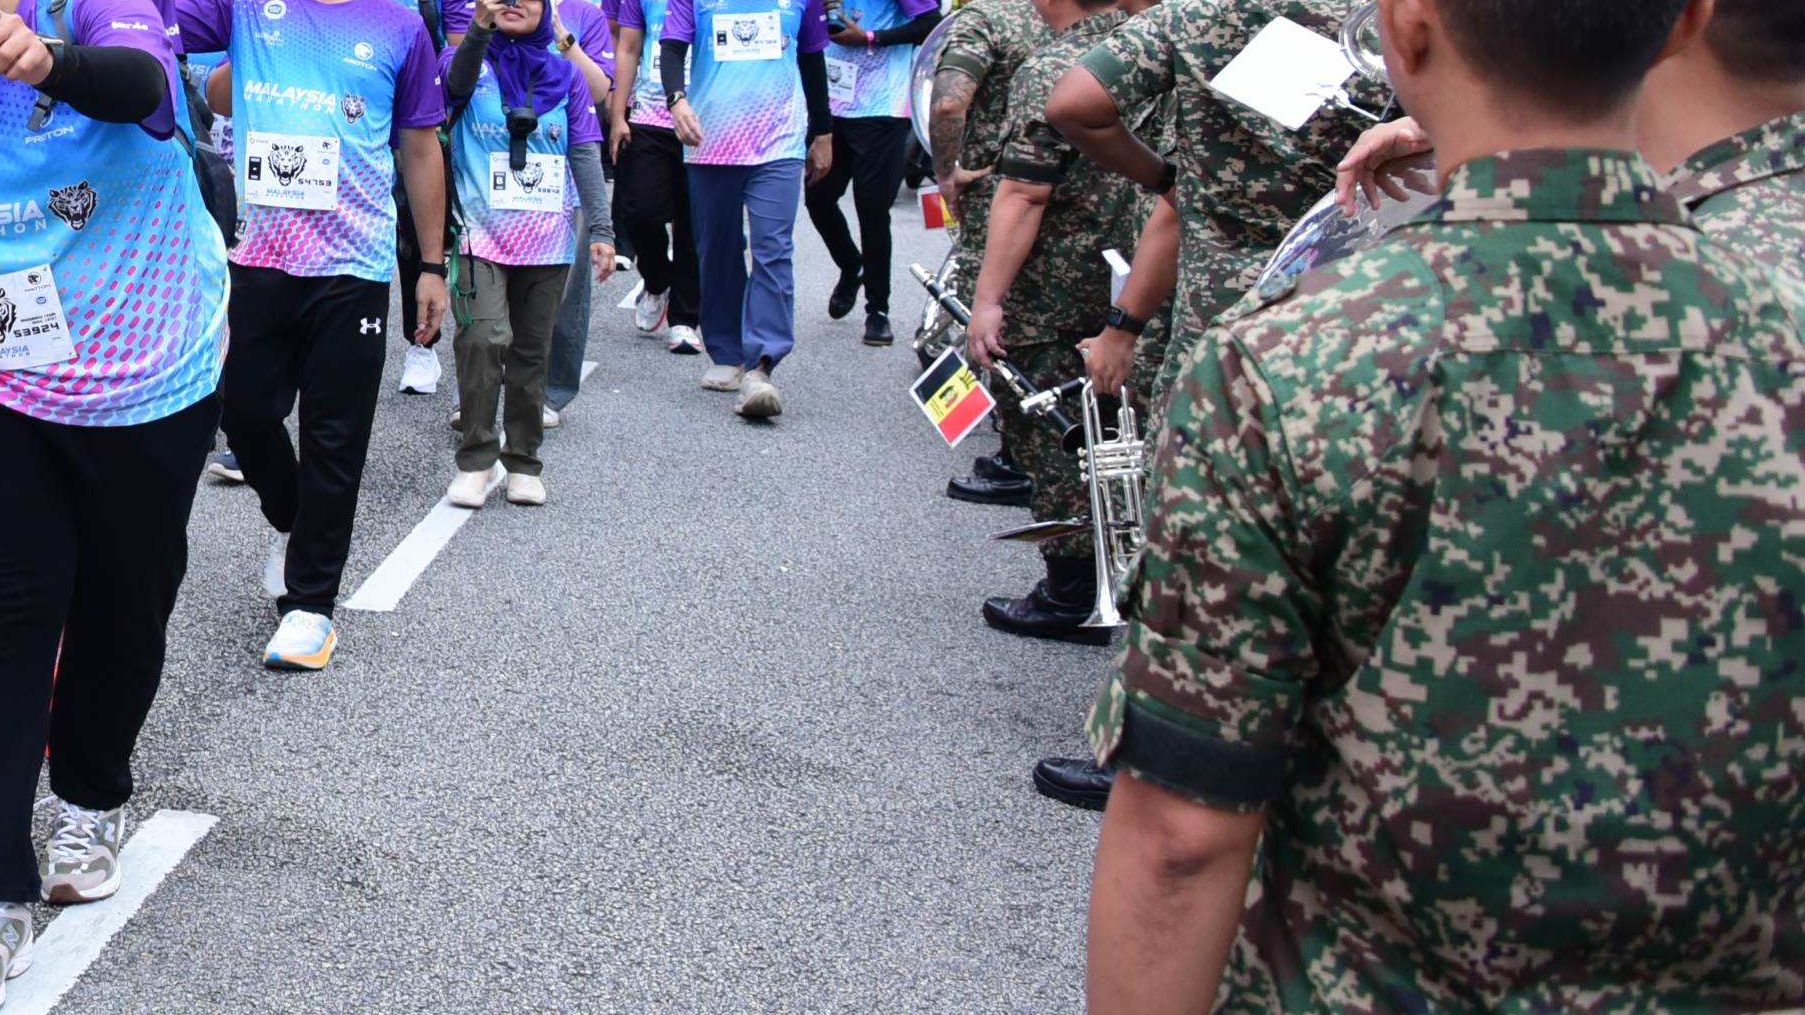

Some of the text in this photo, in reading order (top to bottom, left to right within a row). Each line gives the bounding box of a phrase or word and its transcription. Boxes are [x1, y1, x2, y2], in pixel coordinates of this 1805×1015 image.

[245, 80, 338, 107] MALAYSIA
[24, 125, 75, 145] PROTON
[13, 322, 60, 339] 53924
